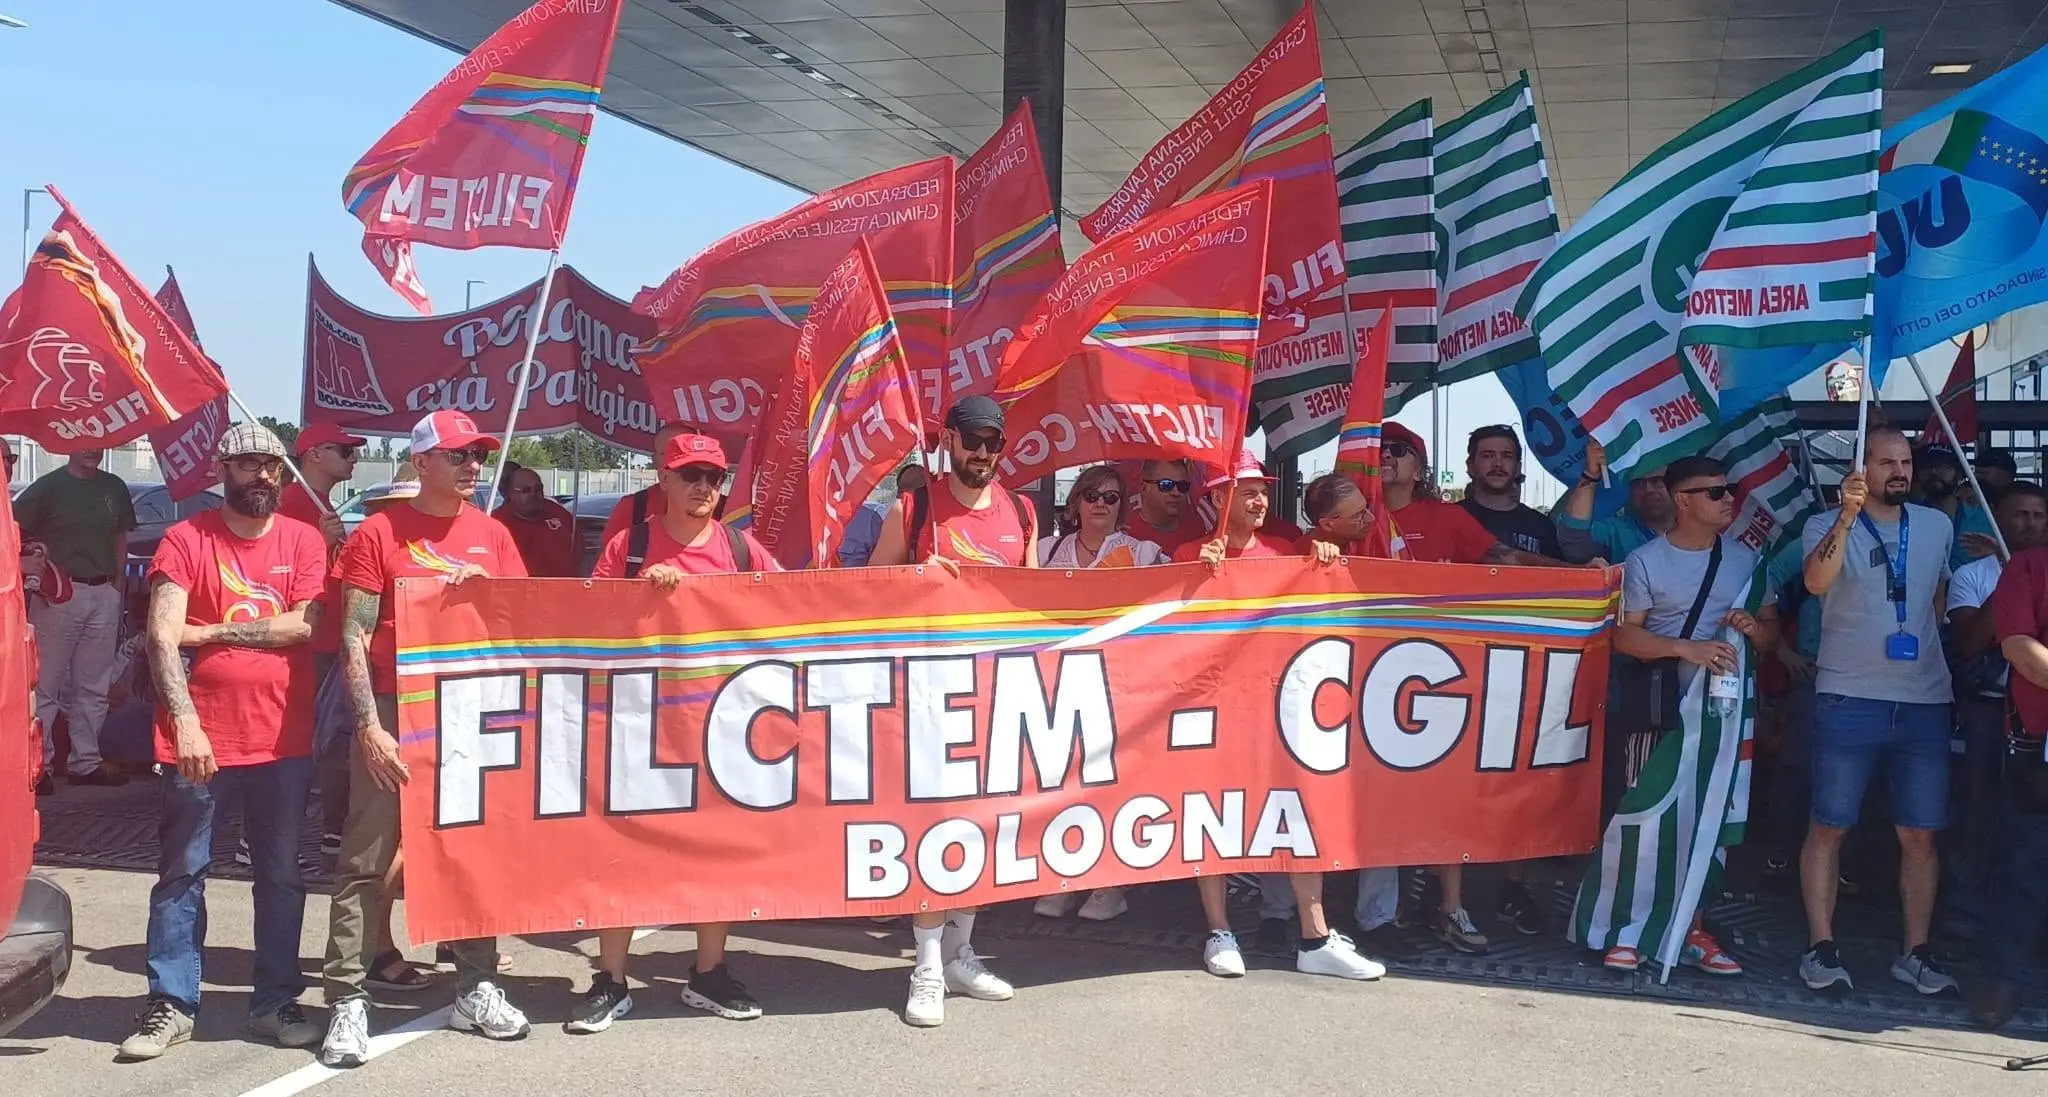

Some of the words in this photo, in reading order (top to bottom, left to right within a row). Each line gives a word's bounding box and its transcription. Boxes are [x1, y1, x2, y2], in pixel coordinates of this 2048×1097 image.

[443, 286, 641, 375] Bologna
[433, 650, 1118, 830] FILCTEM
[1168, 705, 1218, 750] -
[1275, 635, 1593, 775] CGIL
[844, 787, 1320, 900] BOLOGNA
